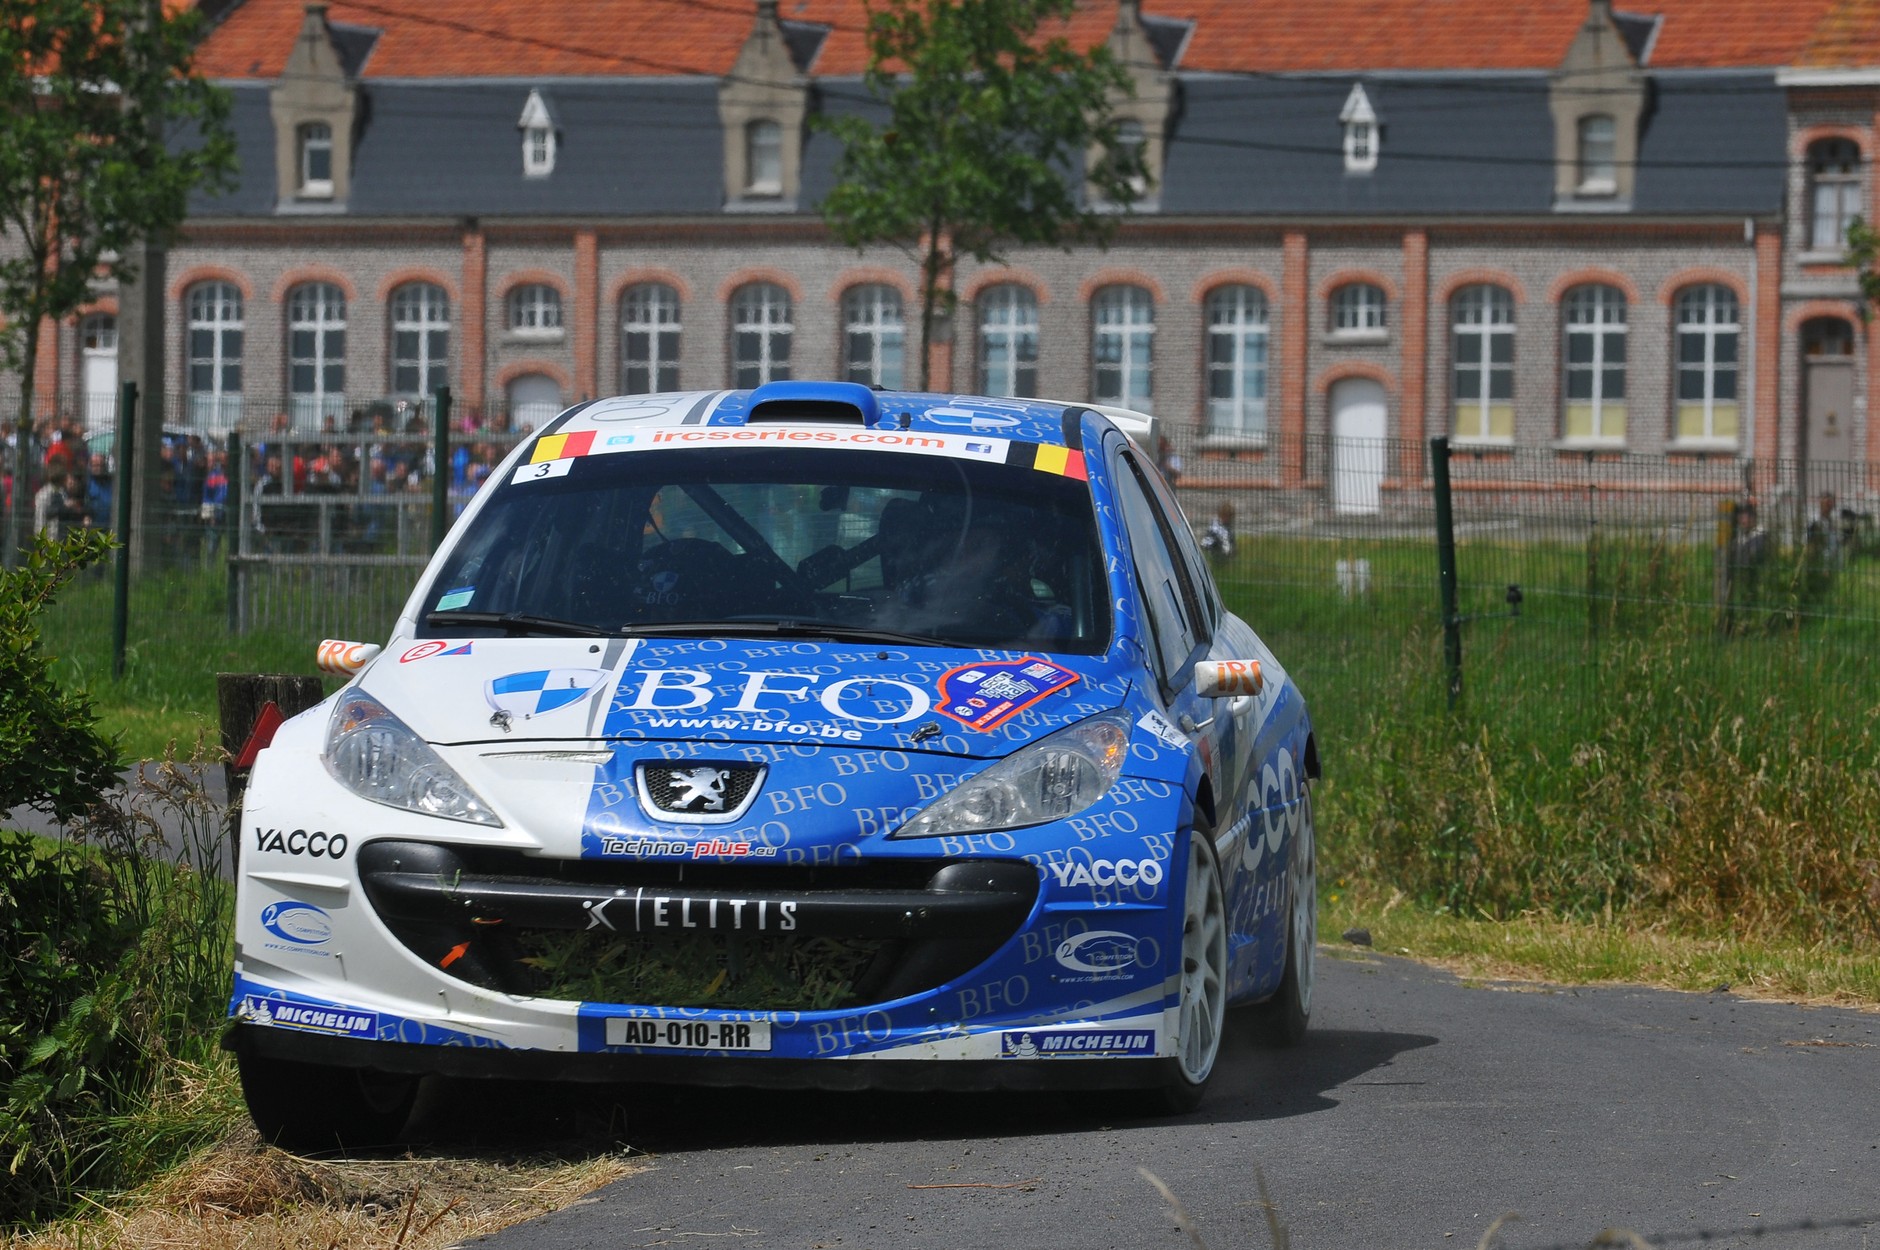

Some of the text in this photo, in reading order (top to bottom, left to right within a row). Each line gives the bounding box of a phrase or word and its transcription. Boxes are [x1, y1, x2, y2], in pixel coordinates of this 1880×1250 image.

[652, 428, 944, 449] ircseries.com
[534, 463, 551, 477] 3
[650, 640, 727, 657] BFO
[741, 643, 821, 658] BFO
[621, 670, 930, 724] BFO
[649, 718, 862, 740] www.bfo.be
[656, 732, 735, 761] BFO
[740, 737, 824, 764] BFO
[829, 750, 910, 777] BFO
[766, 782, 847, 815] BFO
[1108, 779, 1170, 806] BFO
[1066, 810, 1138, 842] BFO
[255, 827, 348, 860] YACCO
[601, 837, 777, 860] Techno-plus.eu
[939, 832, 1016, 857] BFO
[1049, 858, 1163, 887] YACCO
[654, 896, 797, 931] ELITIS
[957, 975, 1029, 1020] BFO
[275, 1006, 372, 1032] MICHELIN
[811, 1010, 892, 1055] BFO
[625, 1021, 751, 1048] AD-010-RR
[1042, 1034, 1150, 1051] MICHELIN
